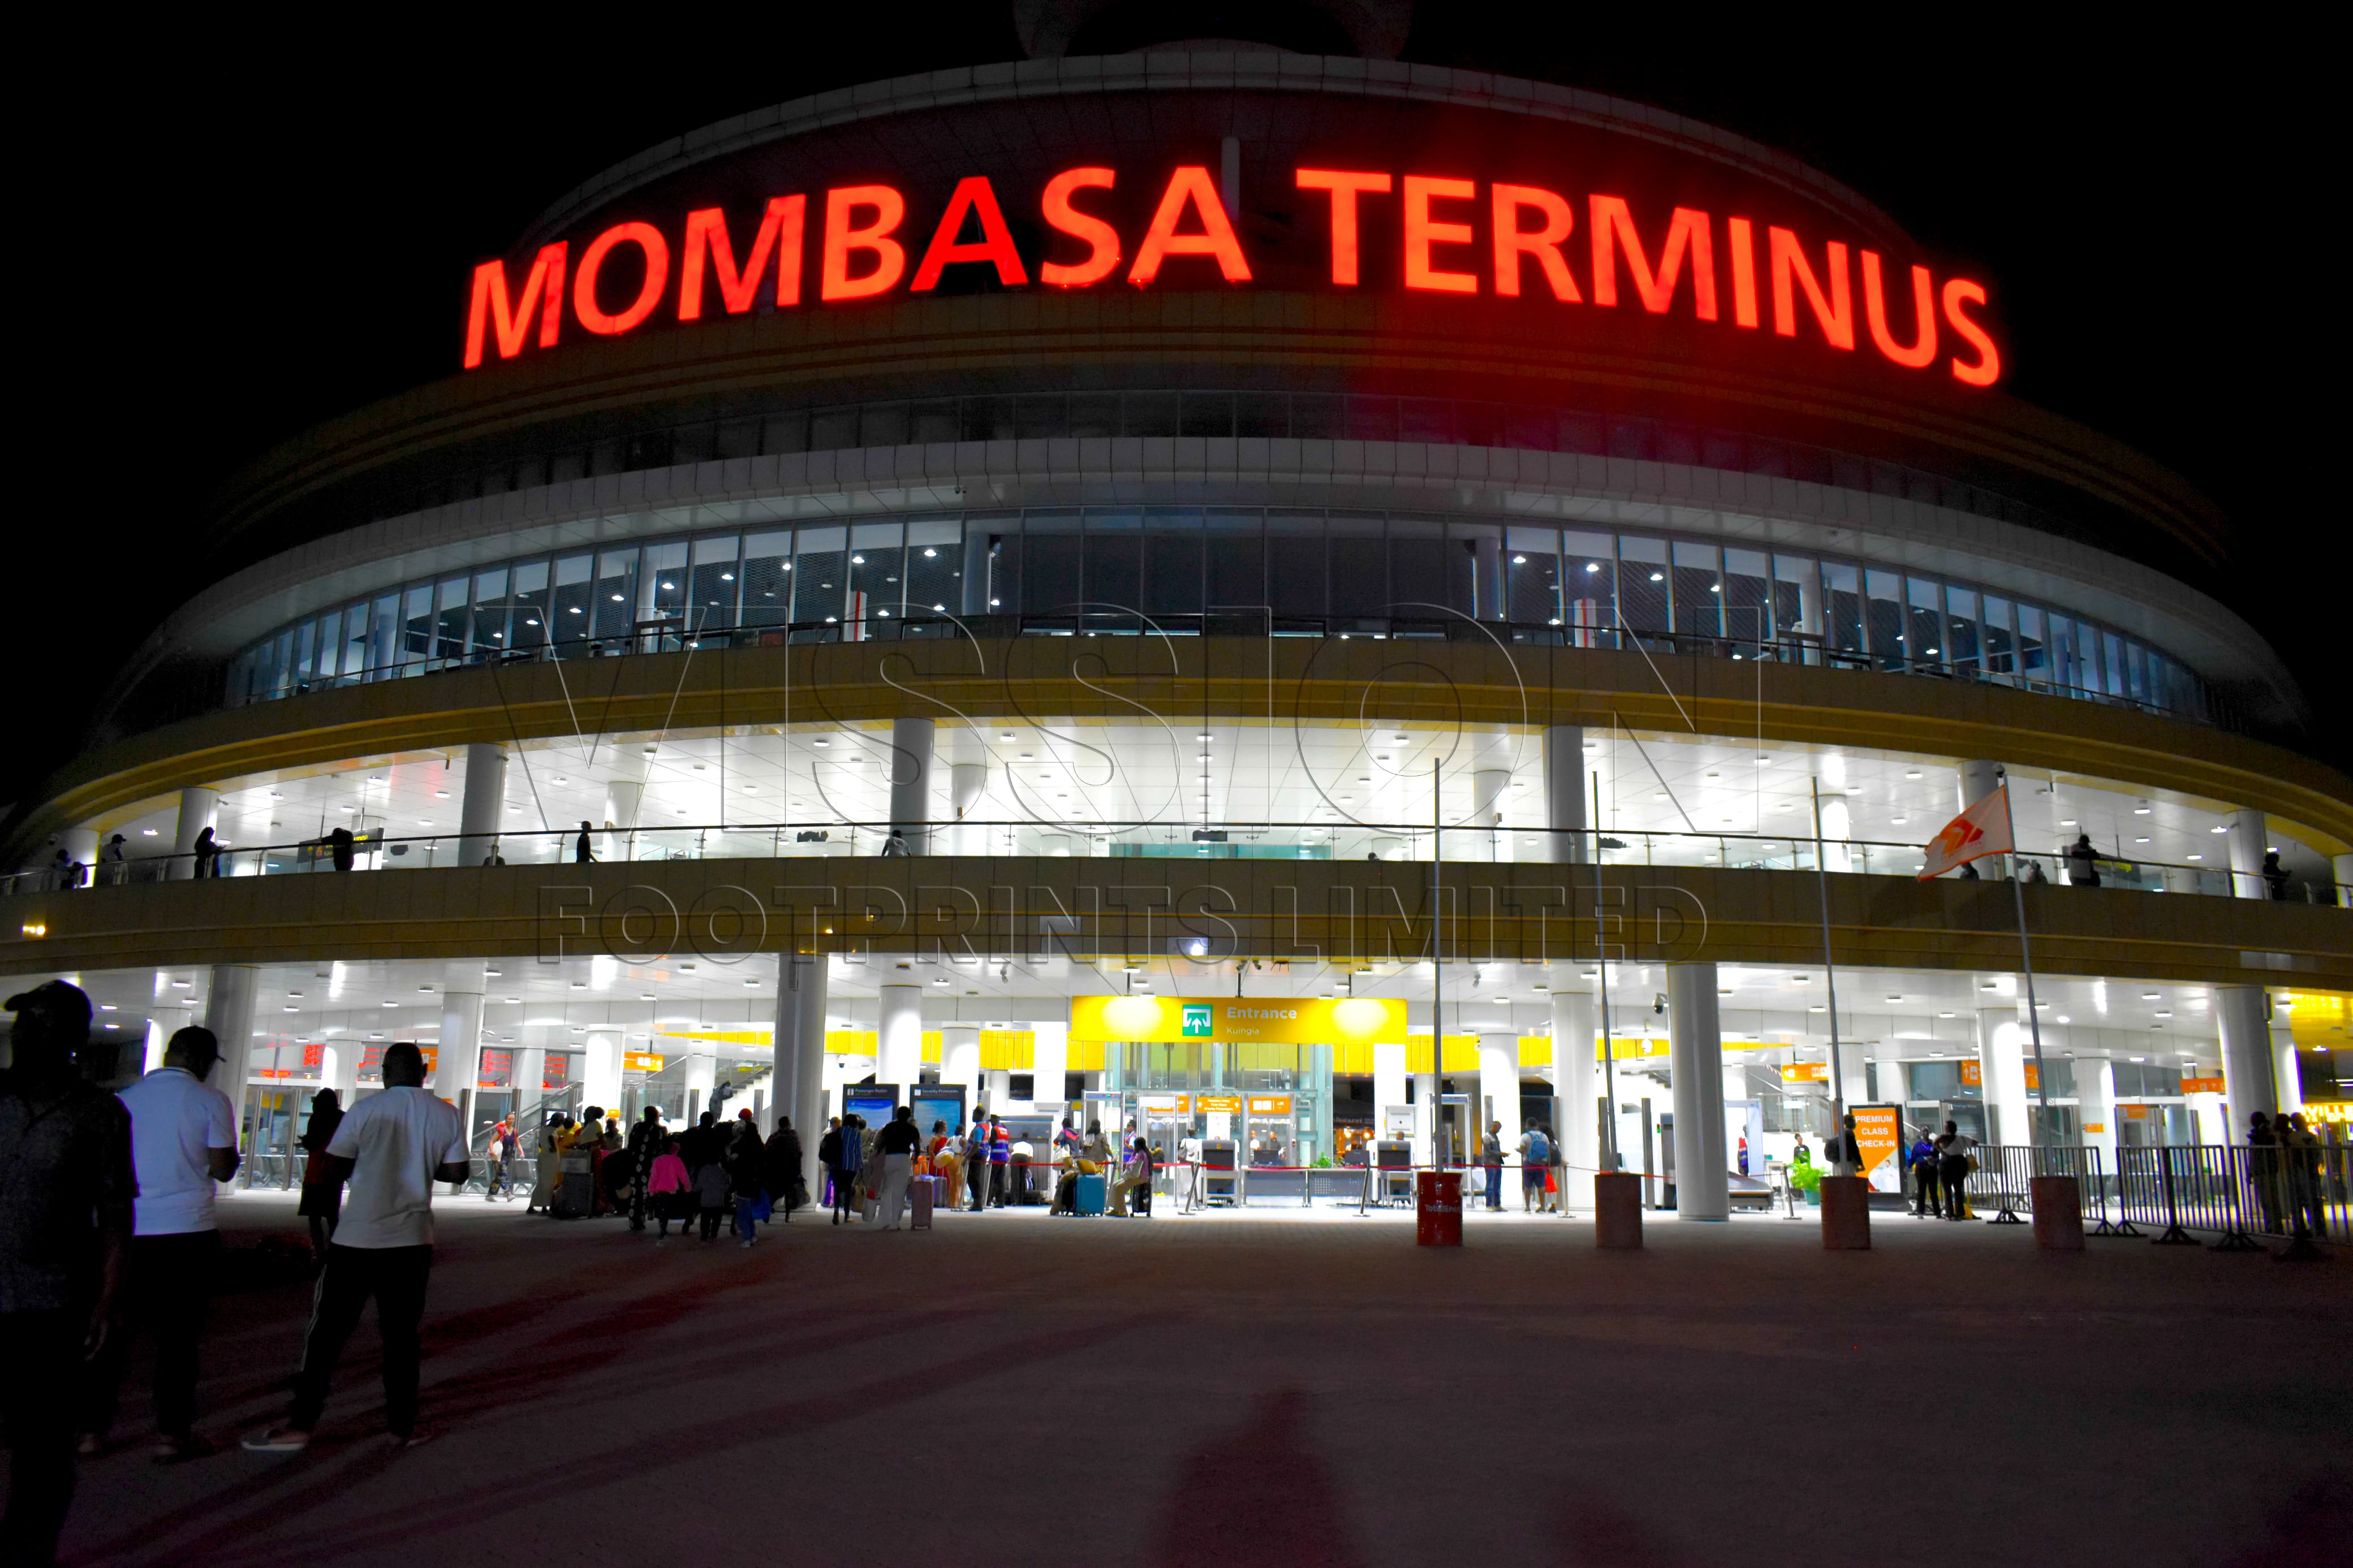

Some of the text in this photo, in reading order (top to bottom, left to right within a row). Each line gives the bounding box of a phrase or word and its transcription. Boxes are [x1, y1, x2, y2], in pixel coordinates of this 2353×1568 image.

[464, 165, 2001, 388] MOMBASA TERMINUS
[1227, 1007, 1297, 1019] Entrance
[1226, 1027, 1260, 1035] Kuingia
